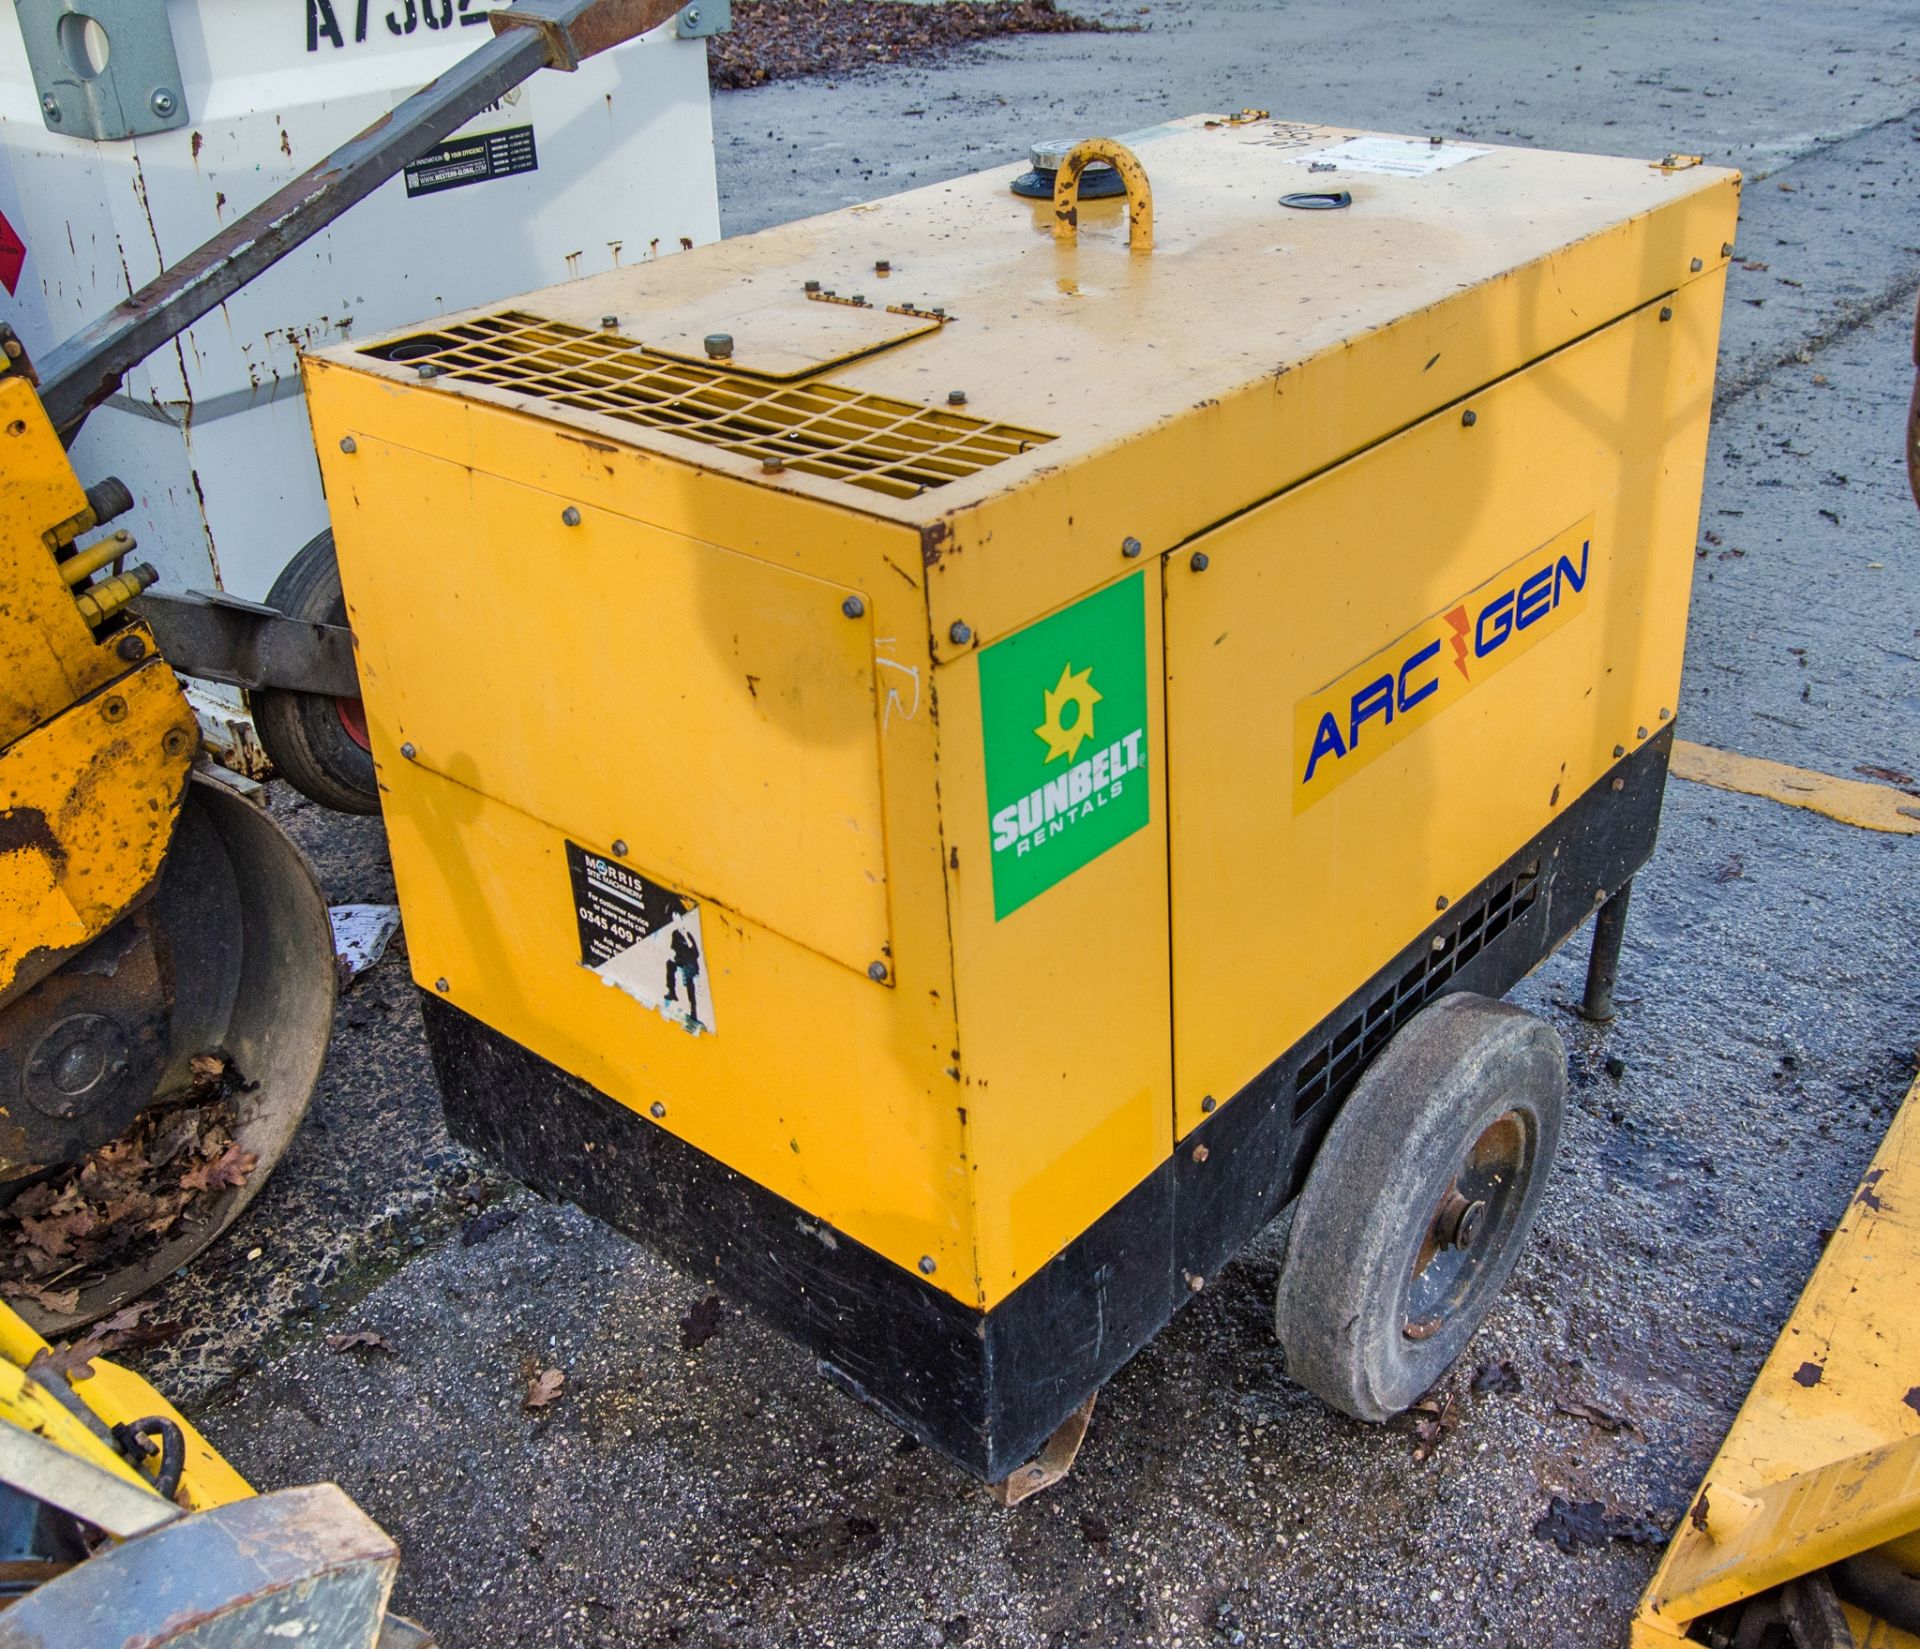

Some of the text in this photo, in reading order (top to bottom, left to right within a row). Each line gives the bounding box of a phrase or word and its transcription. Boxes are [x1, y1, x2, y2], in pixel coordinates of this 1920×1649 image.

[451, 150, 462, 159] YOUR
[462, 146, 485, 156] EFFICIENCY
[420, 163, 487, 184] WWW.WESTERN-GLOBAL.COM
[1302, 539, 1590, 785] ARC GEN
[991, 728, 1143, 853] SUNBELT
[1016, 780, 1124, 858] RENTALS
[585, 854, 643, 891] MORRIS
[586, 867, 643, 900] SITE MACHINERY
[579, 907, 633, 943] 0345 409
[588, 891, 649, 927] For customer service
[601, 907, 617, 920] spare
[618, 916, 635, 929] parts
[635, 924, 646, 934] call
